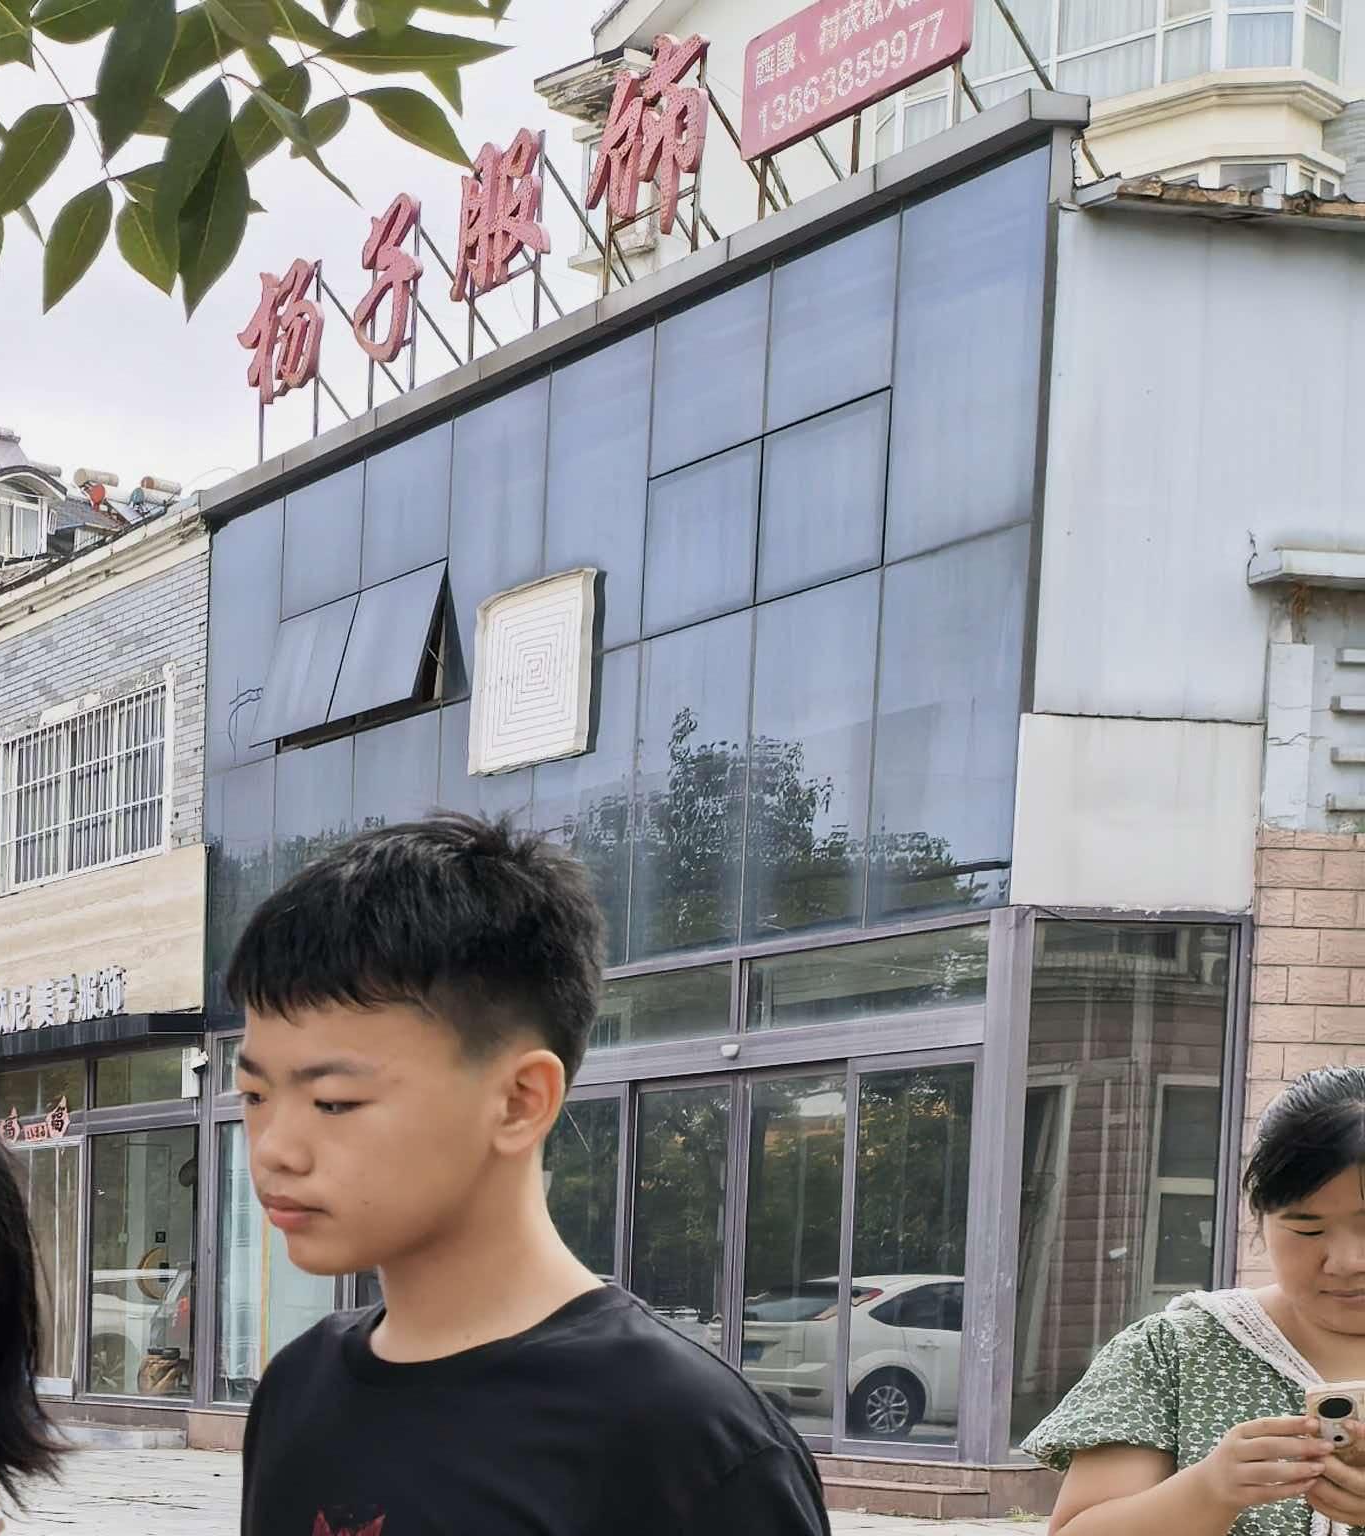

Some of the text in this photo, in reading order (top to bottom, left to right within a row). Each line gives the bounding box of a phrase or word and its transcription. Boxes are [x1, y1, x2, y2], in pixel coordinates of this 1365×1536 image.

[758, 9, 945, 137] 13863859977
[238, 33, 709, 404] 杨子服饰
